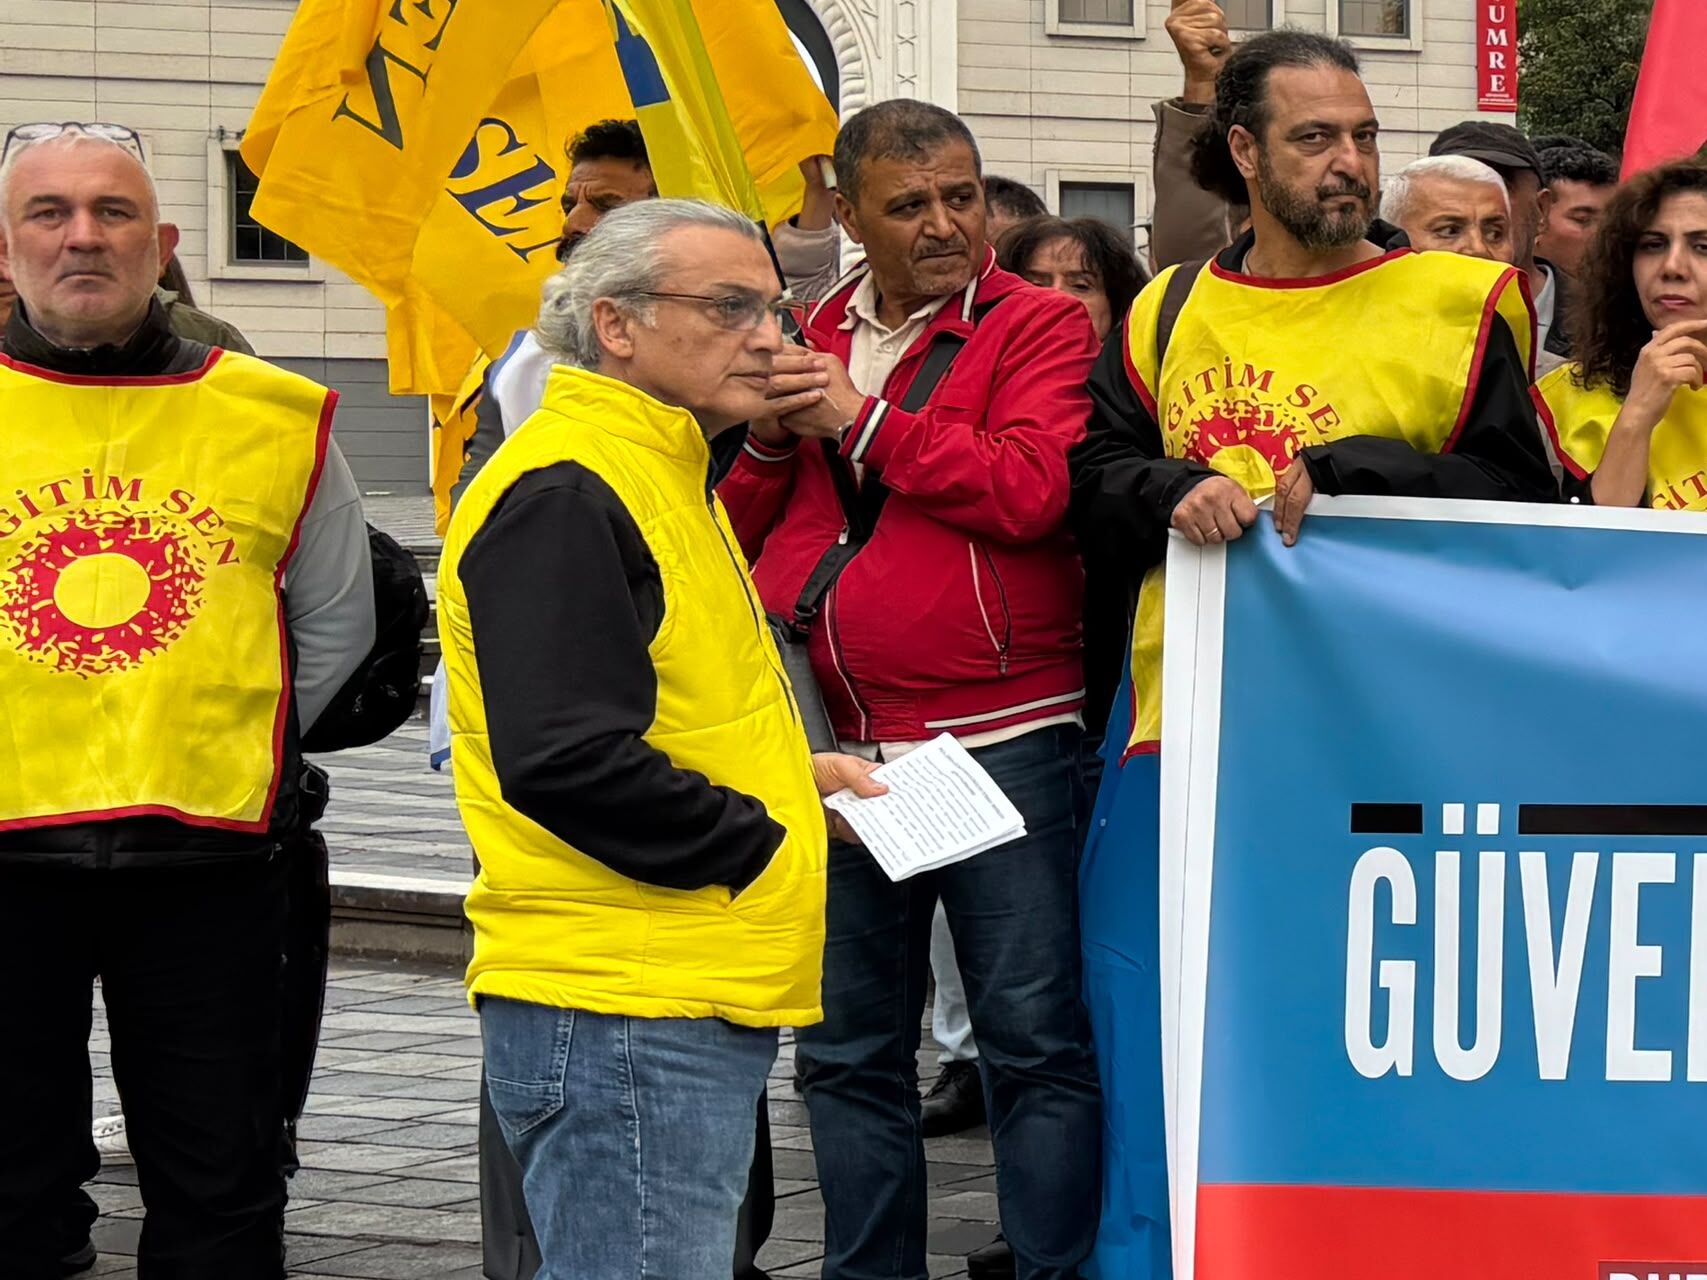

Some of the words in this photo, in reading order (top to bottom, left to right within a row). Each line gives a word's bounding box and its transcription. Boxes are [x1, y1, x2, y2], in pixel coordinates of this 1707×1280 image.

[1486, 5, 1509, 93] UMRE
[1286, 383, 1341, 435] SE
[161, 489, 240, 566] SEN
